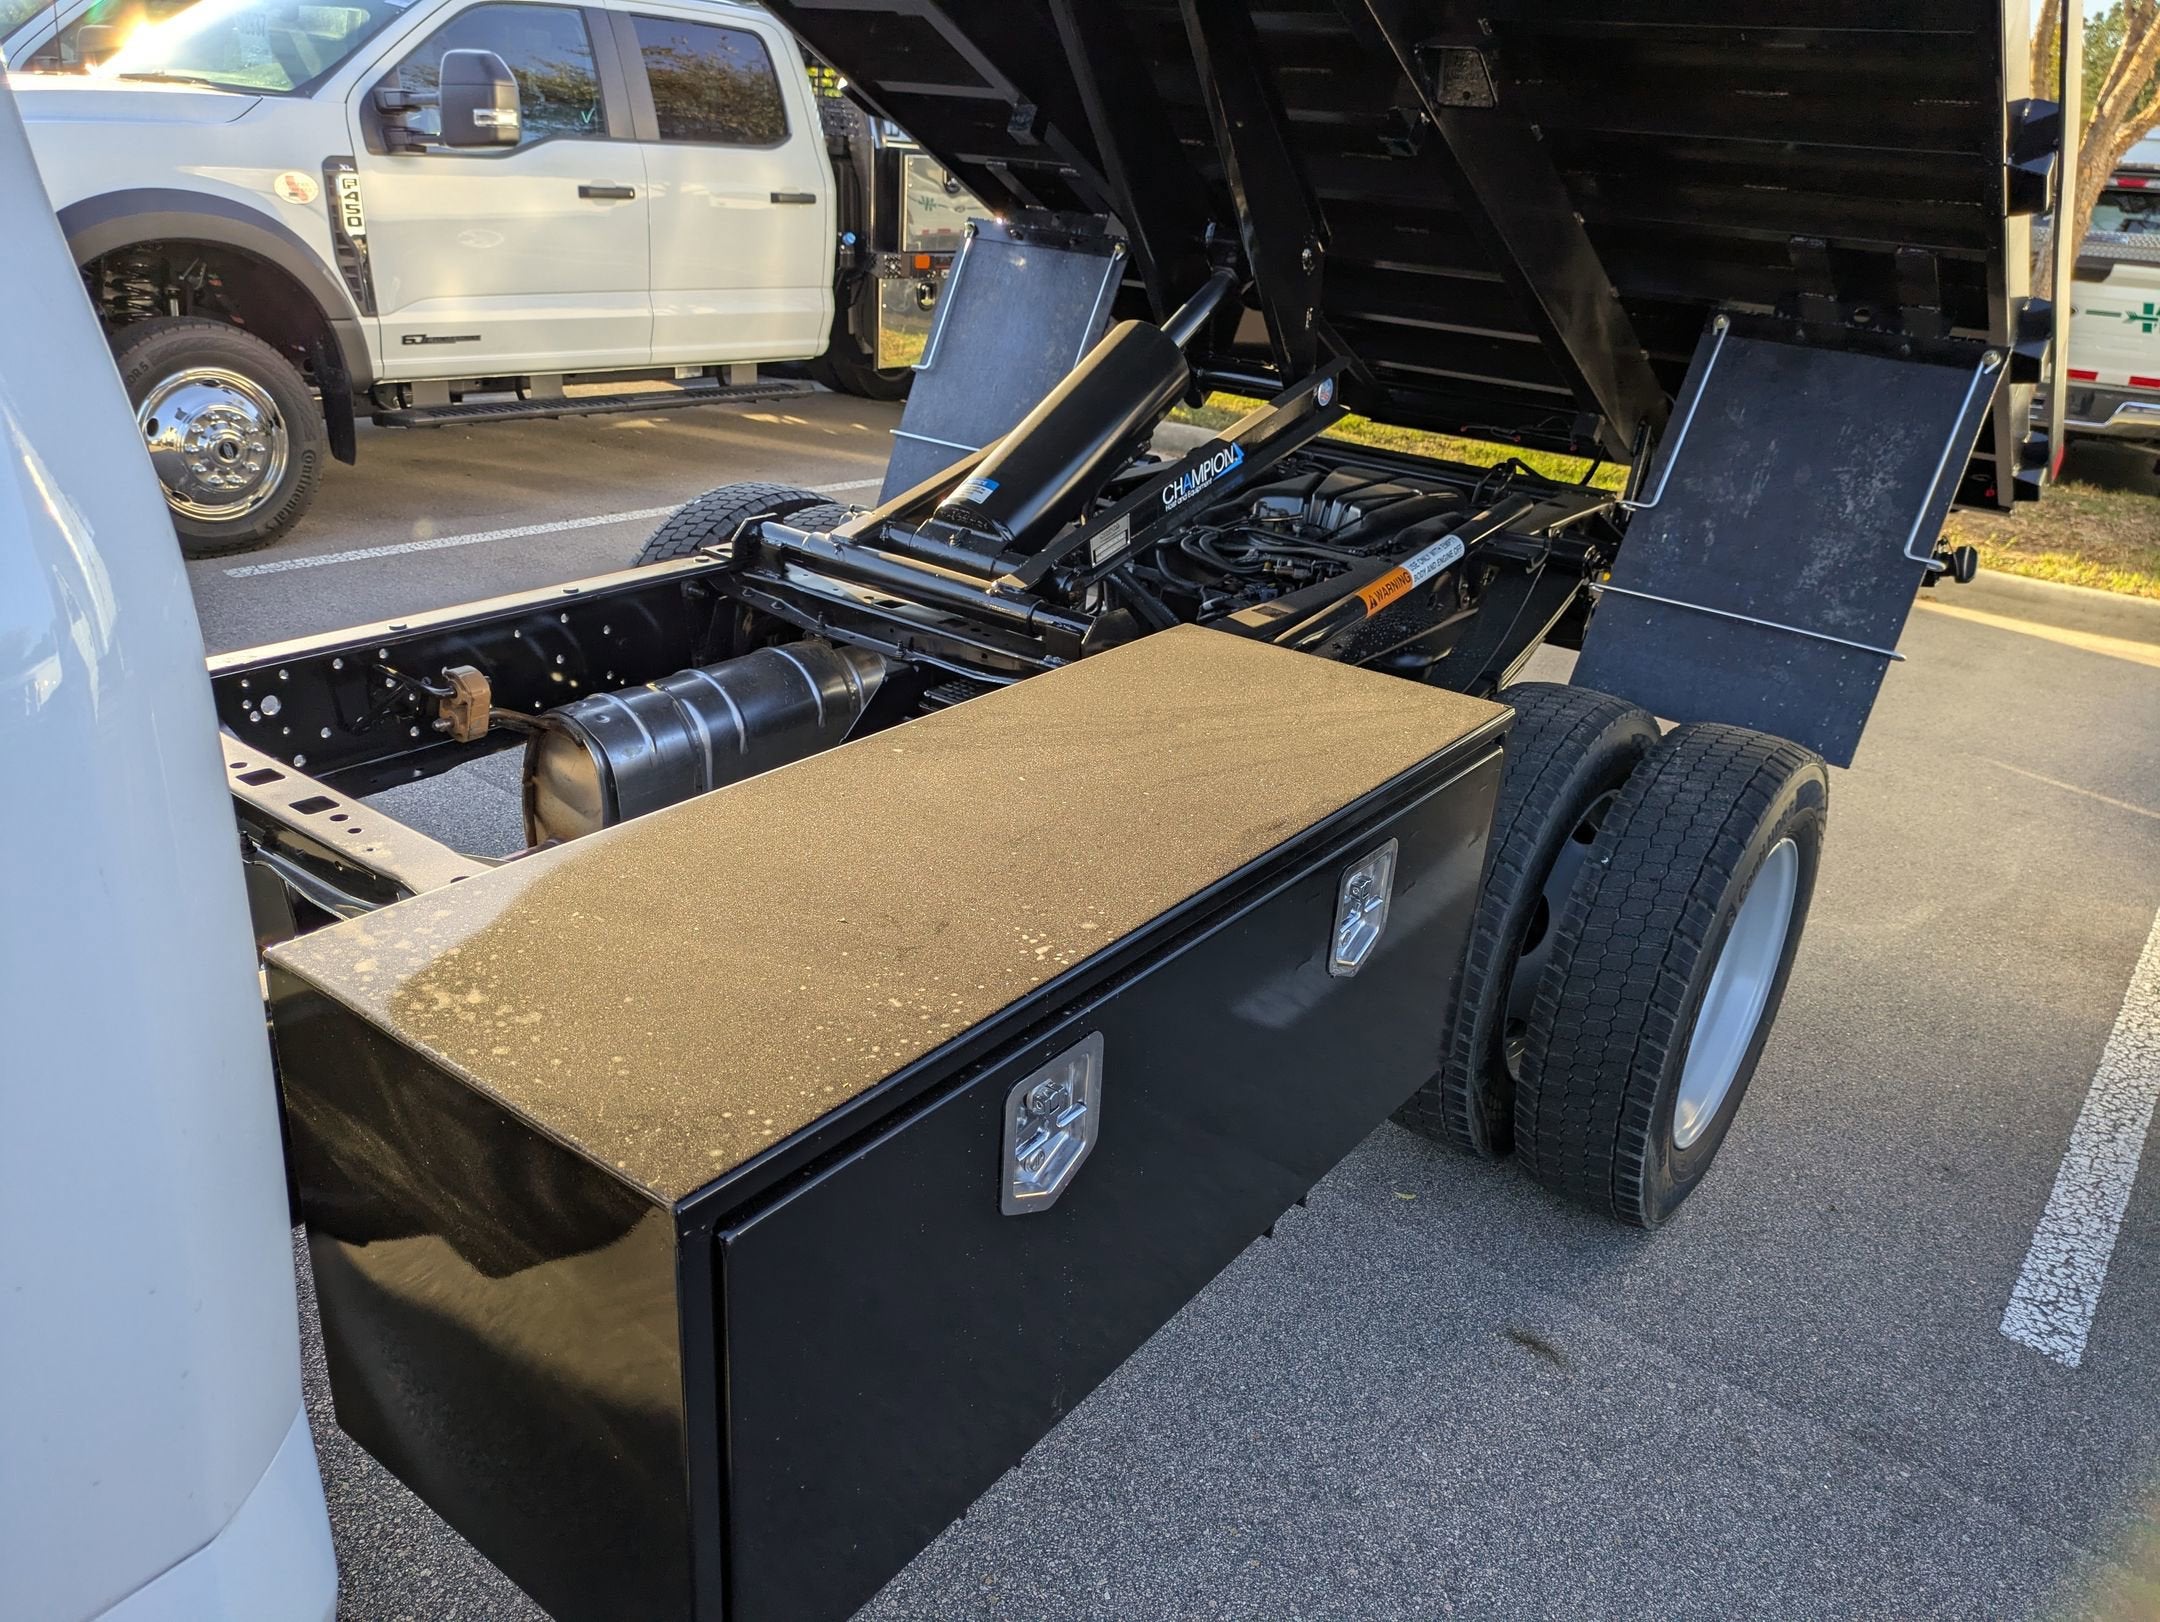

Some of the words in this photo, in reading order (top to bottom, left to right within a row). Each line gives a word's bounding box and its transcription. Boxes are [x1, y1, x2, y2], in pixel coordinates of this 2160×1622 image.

[1163, 446, 1234, 504] CHAMPION
[1177, 493, 1188, 505] and
[1187, 478, 1213, 498] Equipment
[1426, 561, 1437, 572] AND
[1436, 550, 1454, 567] ENGINE
[1453, 543, 1463, 555] OFF
[1375, 571, 1411, 602] WARNING
